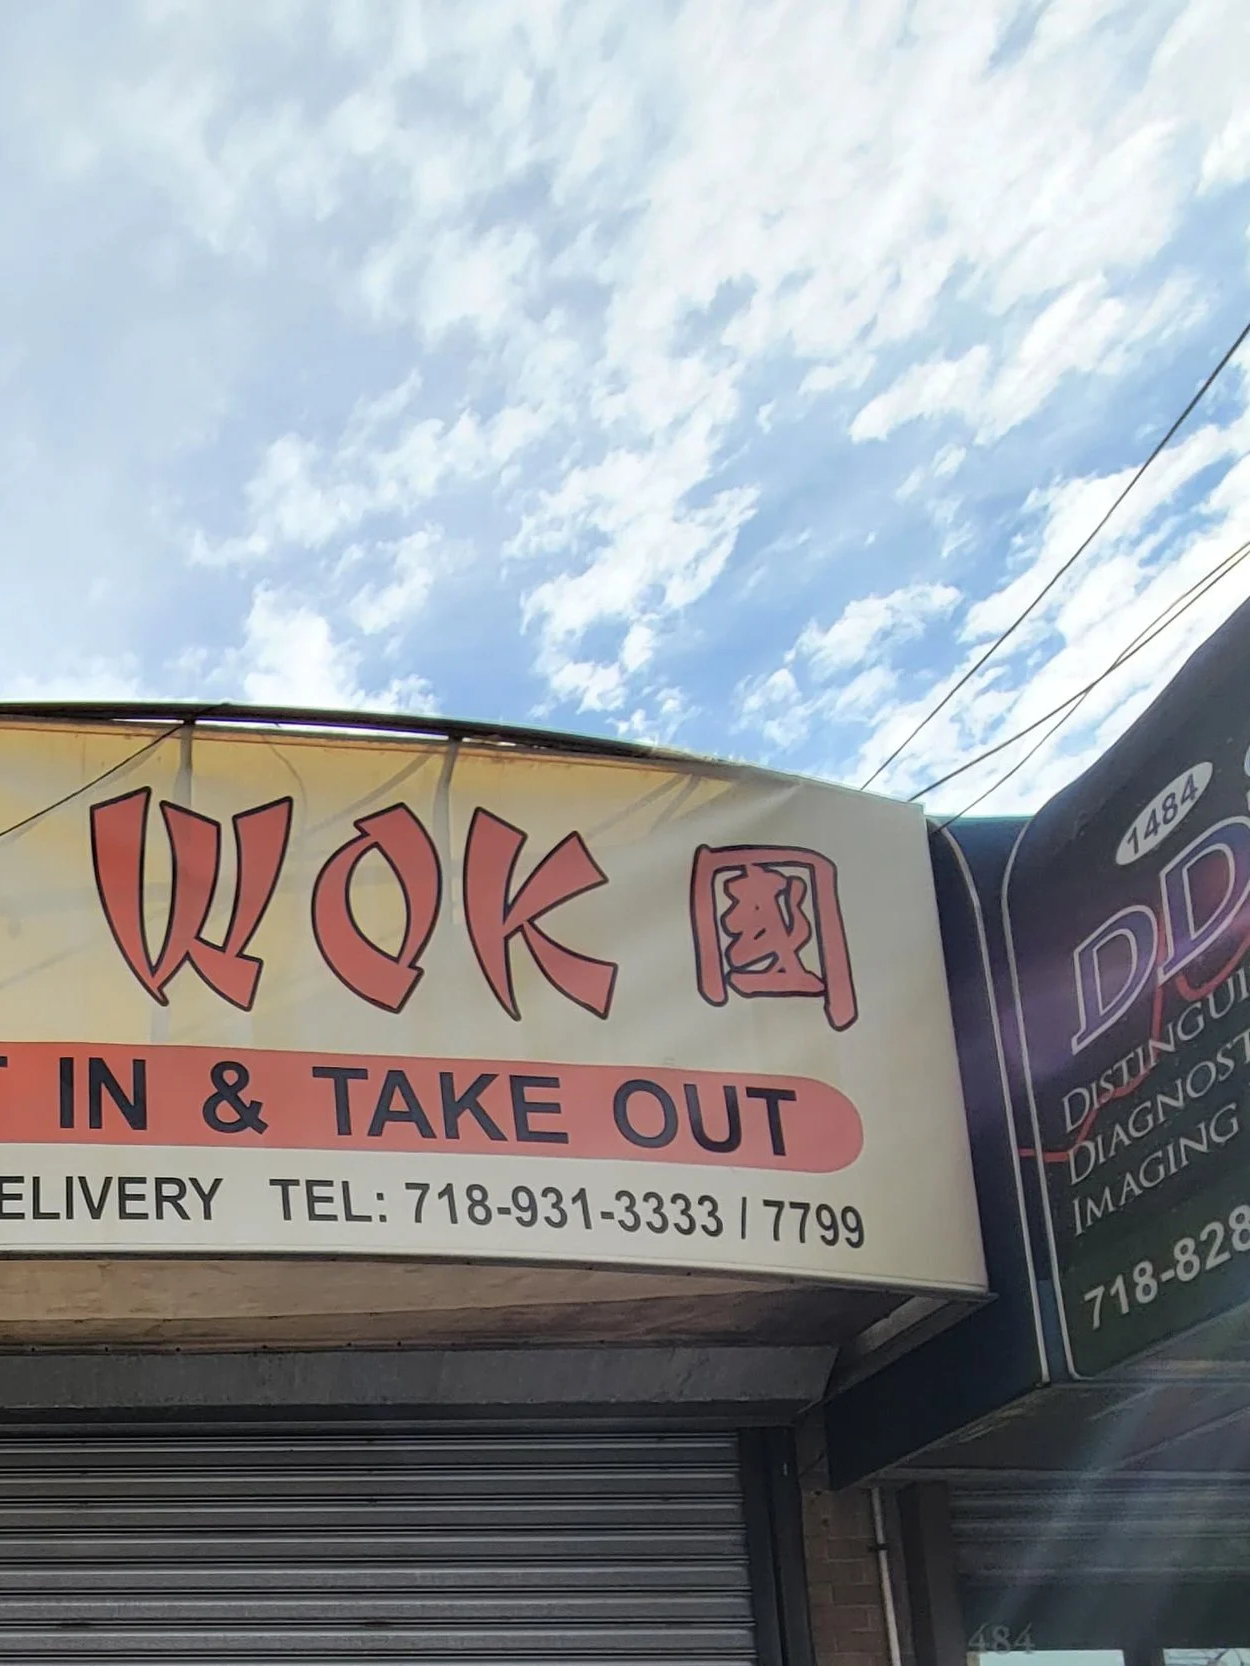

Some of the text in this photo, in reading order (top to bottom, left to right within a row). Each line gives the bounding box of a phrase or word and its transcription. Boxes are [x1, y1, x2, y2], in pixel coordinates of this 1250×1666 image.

[1127, 773, 1198, 856] 1484
[88, 785, 618, 1022] WOK
[58, 1057, 149, 1131] IN
[203, 1060, 270, 1135] &
[312, 1066, 569, 1145] TAKE
[611, 1080, 797, 1157] OUT
[269, 1179, 389, 1225] TEL:
[404, 1182, 724, 1238] 718-931-3333
[763, 1200, 866, 1248] 7799
[1072, 1102, 1240, 1237] IMAGING
